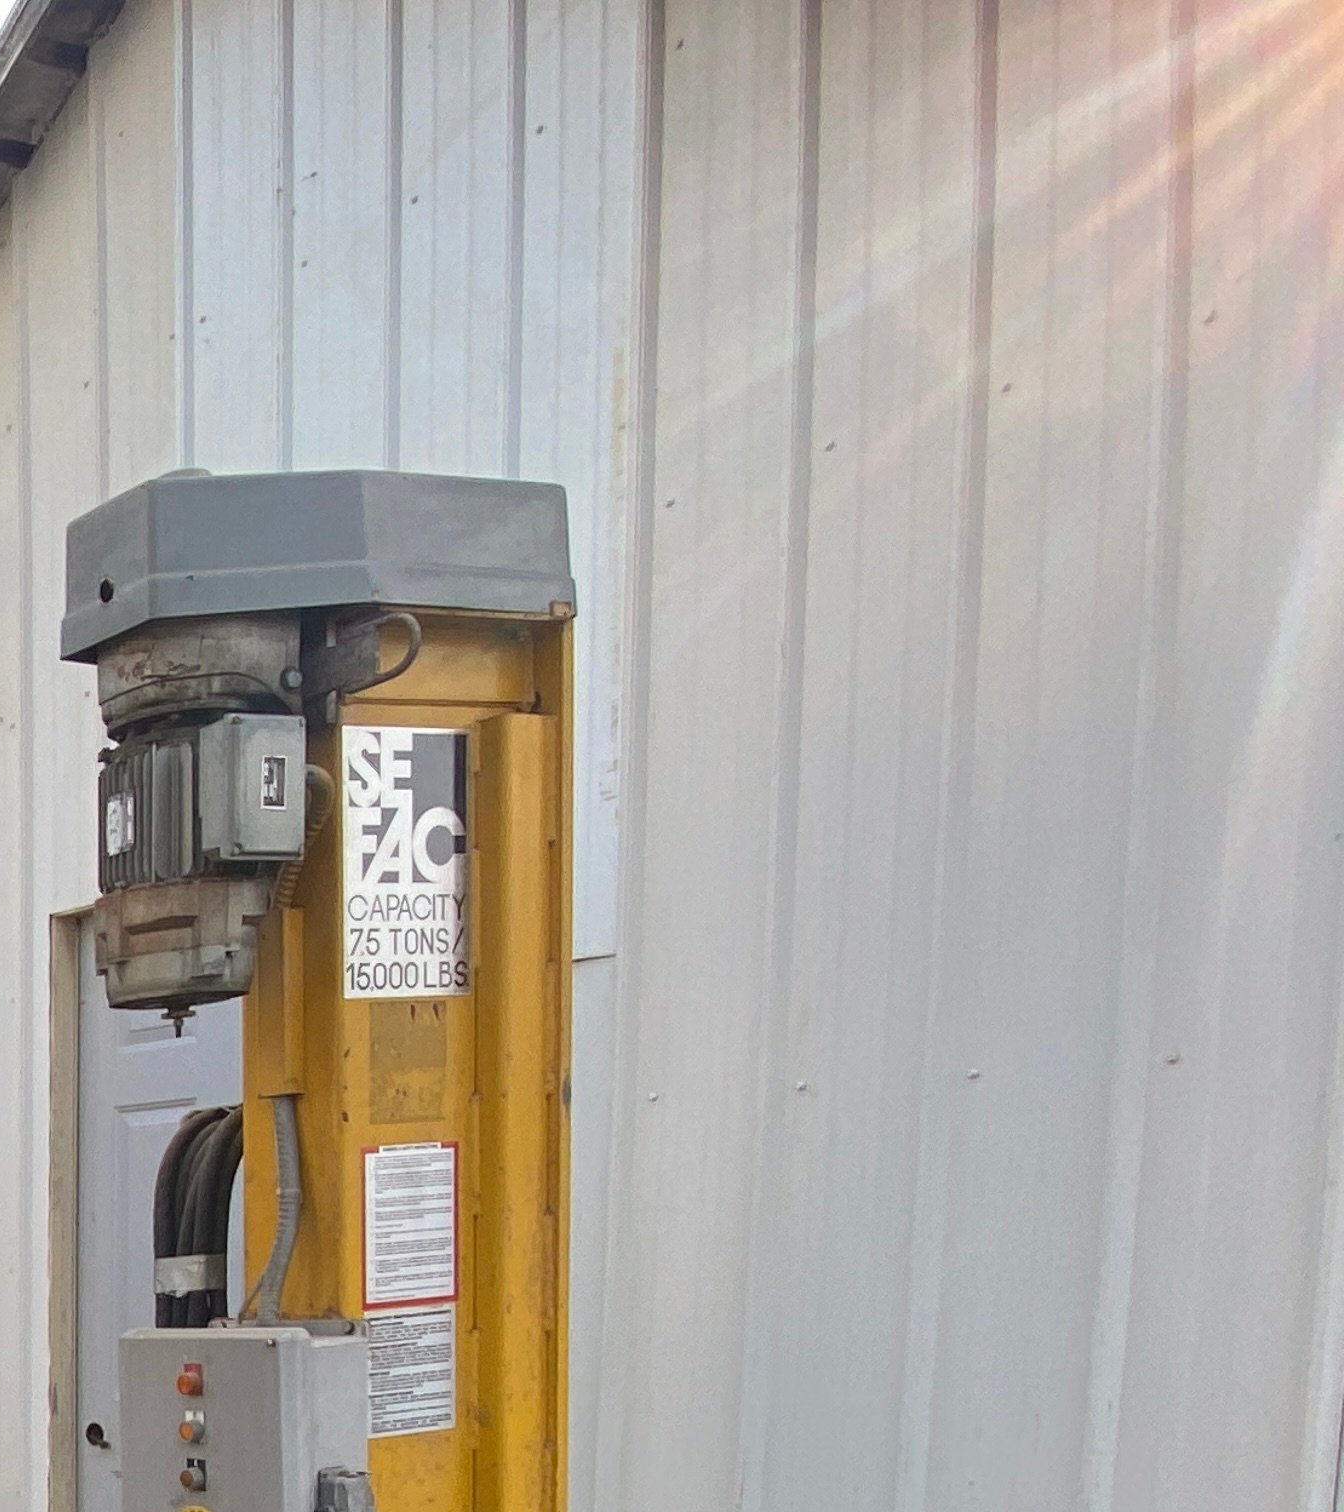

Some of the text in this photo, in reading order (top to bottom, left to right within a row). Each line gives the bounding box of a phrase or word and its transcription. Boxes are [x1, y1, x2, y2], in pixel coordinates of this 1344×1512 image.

[348, 731, 412, 808] SE
[348, 800, 466, 884] FAC
[347, 893, 466, 921] CAPACITY
[388, 927, 465, 955] TONS/
[346, 962, 420, 993] 15,000
